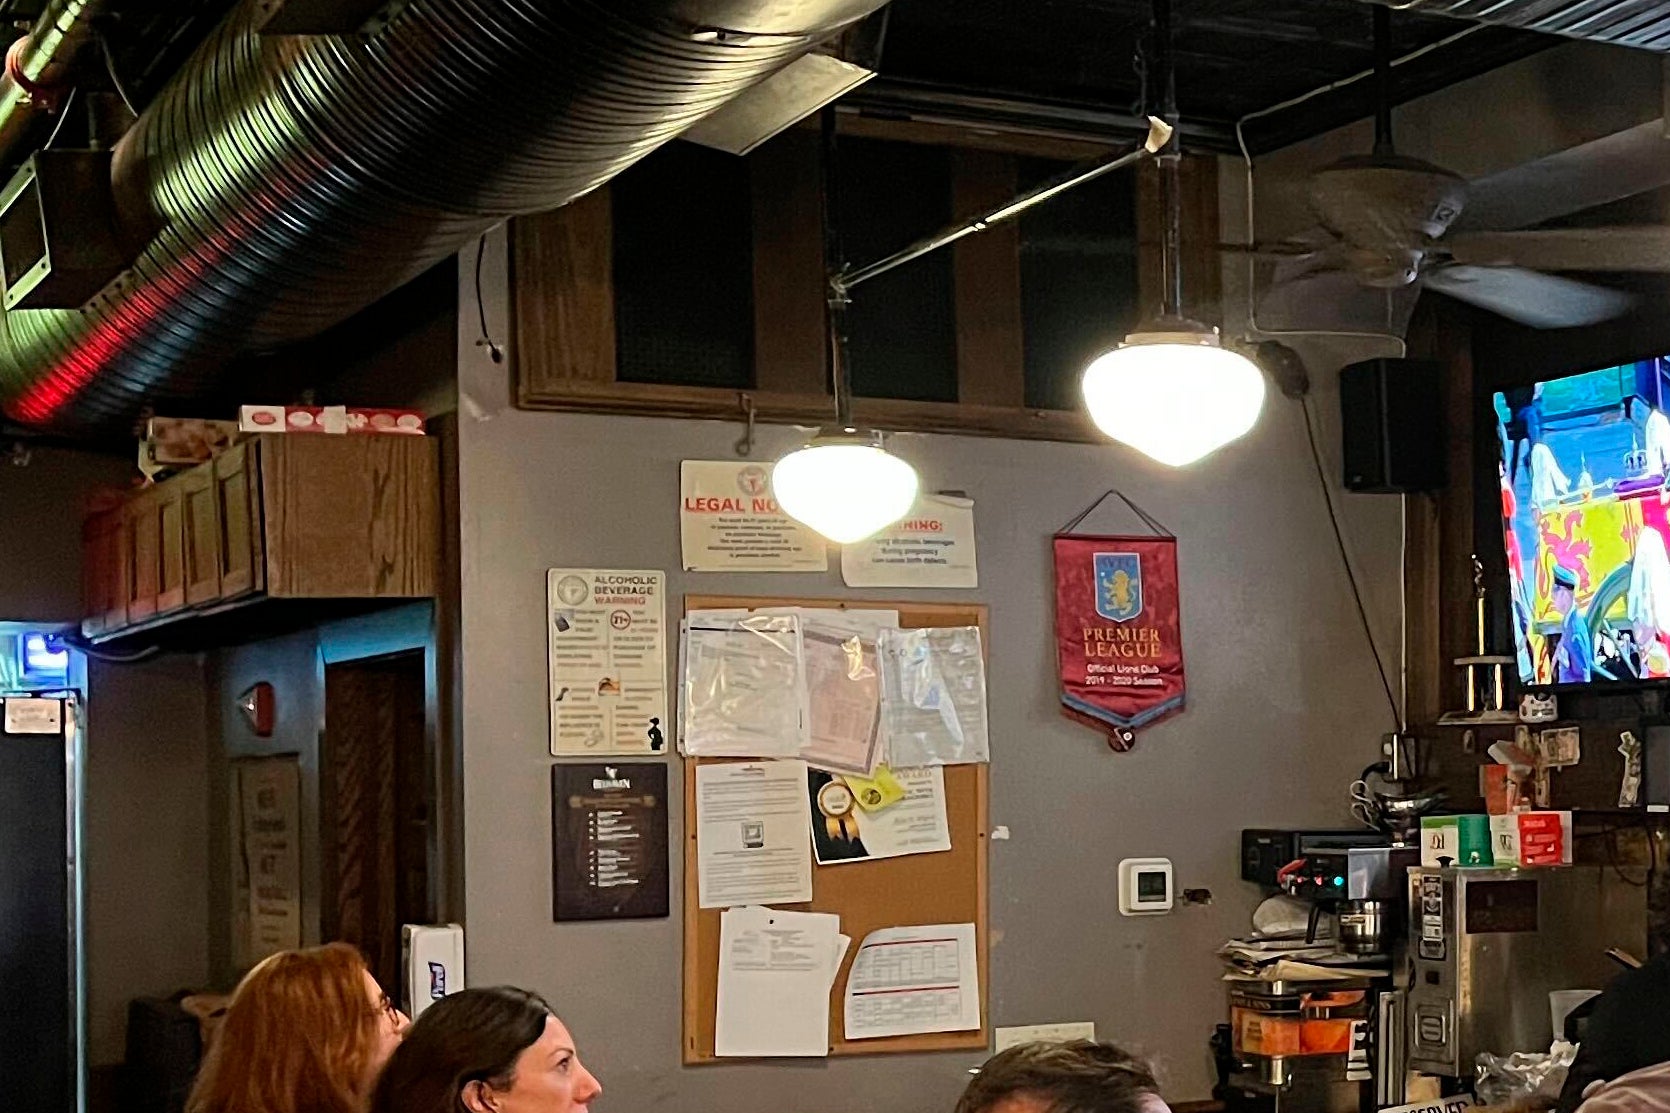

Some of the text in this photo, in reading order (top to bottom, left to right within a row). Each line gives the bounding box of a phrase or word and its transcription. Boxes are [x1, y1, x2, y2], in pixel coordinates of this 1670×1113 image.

[685, 497, 746, 513] LEGAL
[594, 576, 657, 585] ALCOHOLIC
[594, 586, 654, 595] BEVERAGE
[1083, 628, 1160, 642] PREMIER
[1084, 642, 1161, 658] LEAGUE
